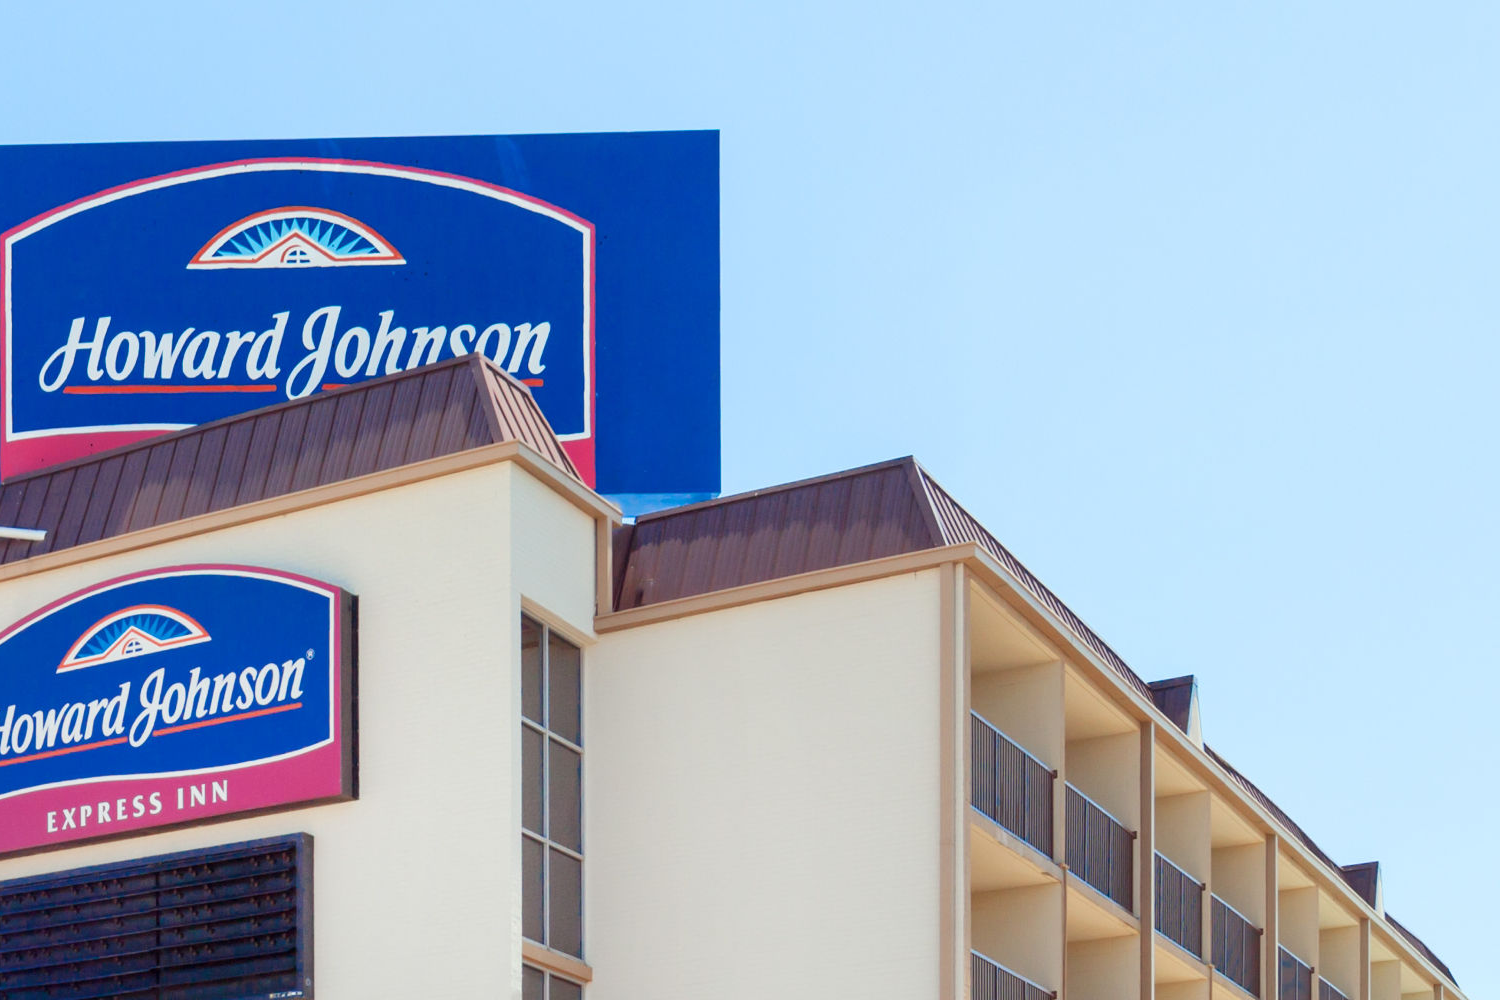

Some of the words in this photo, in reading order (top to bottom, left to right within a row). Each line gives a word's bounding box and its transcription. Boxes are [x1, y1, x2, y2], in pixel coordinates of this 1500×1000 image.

[39, 311, 290, 392] Howard
[285, 305, 551, 401] Johnson
[47, 791, 163, 833] EXPRESS
[177, 779, 229, 810] INN
